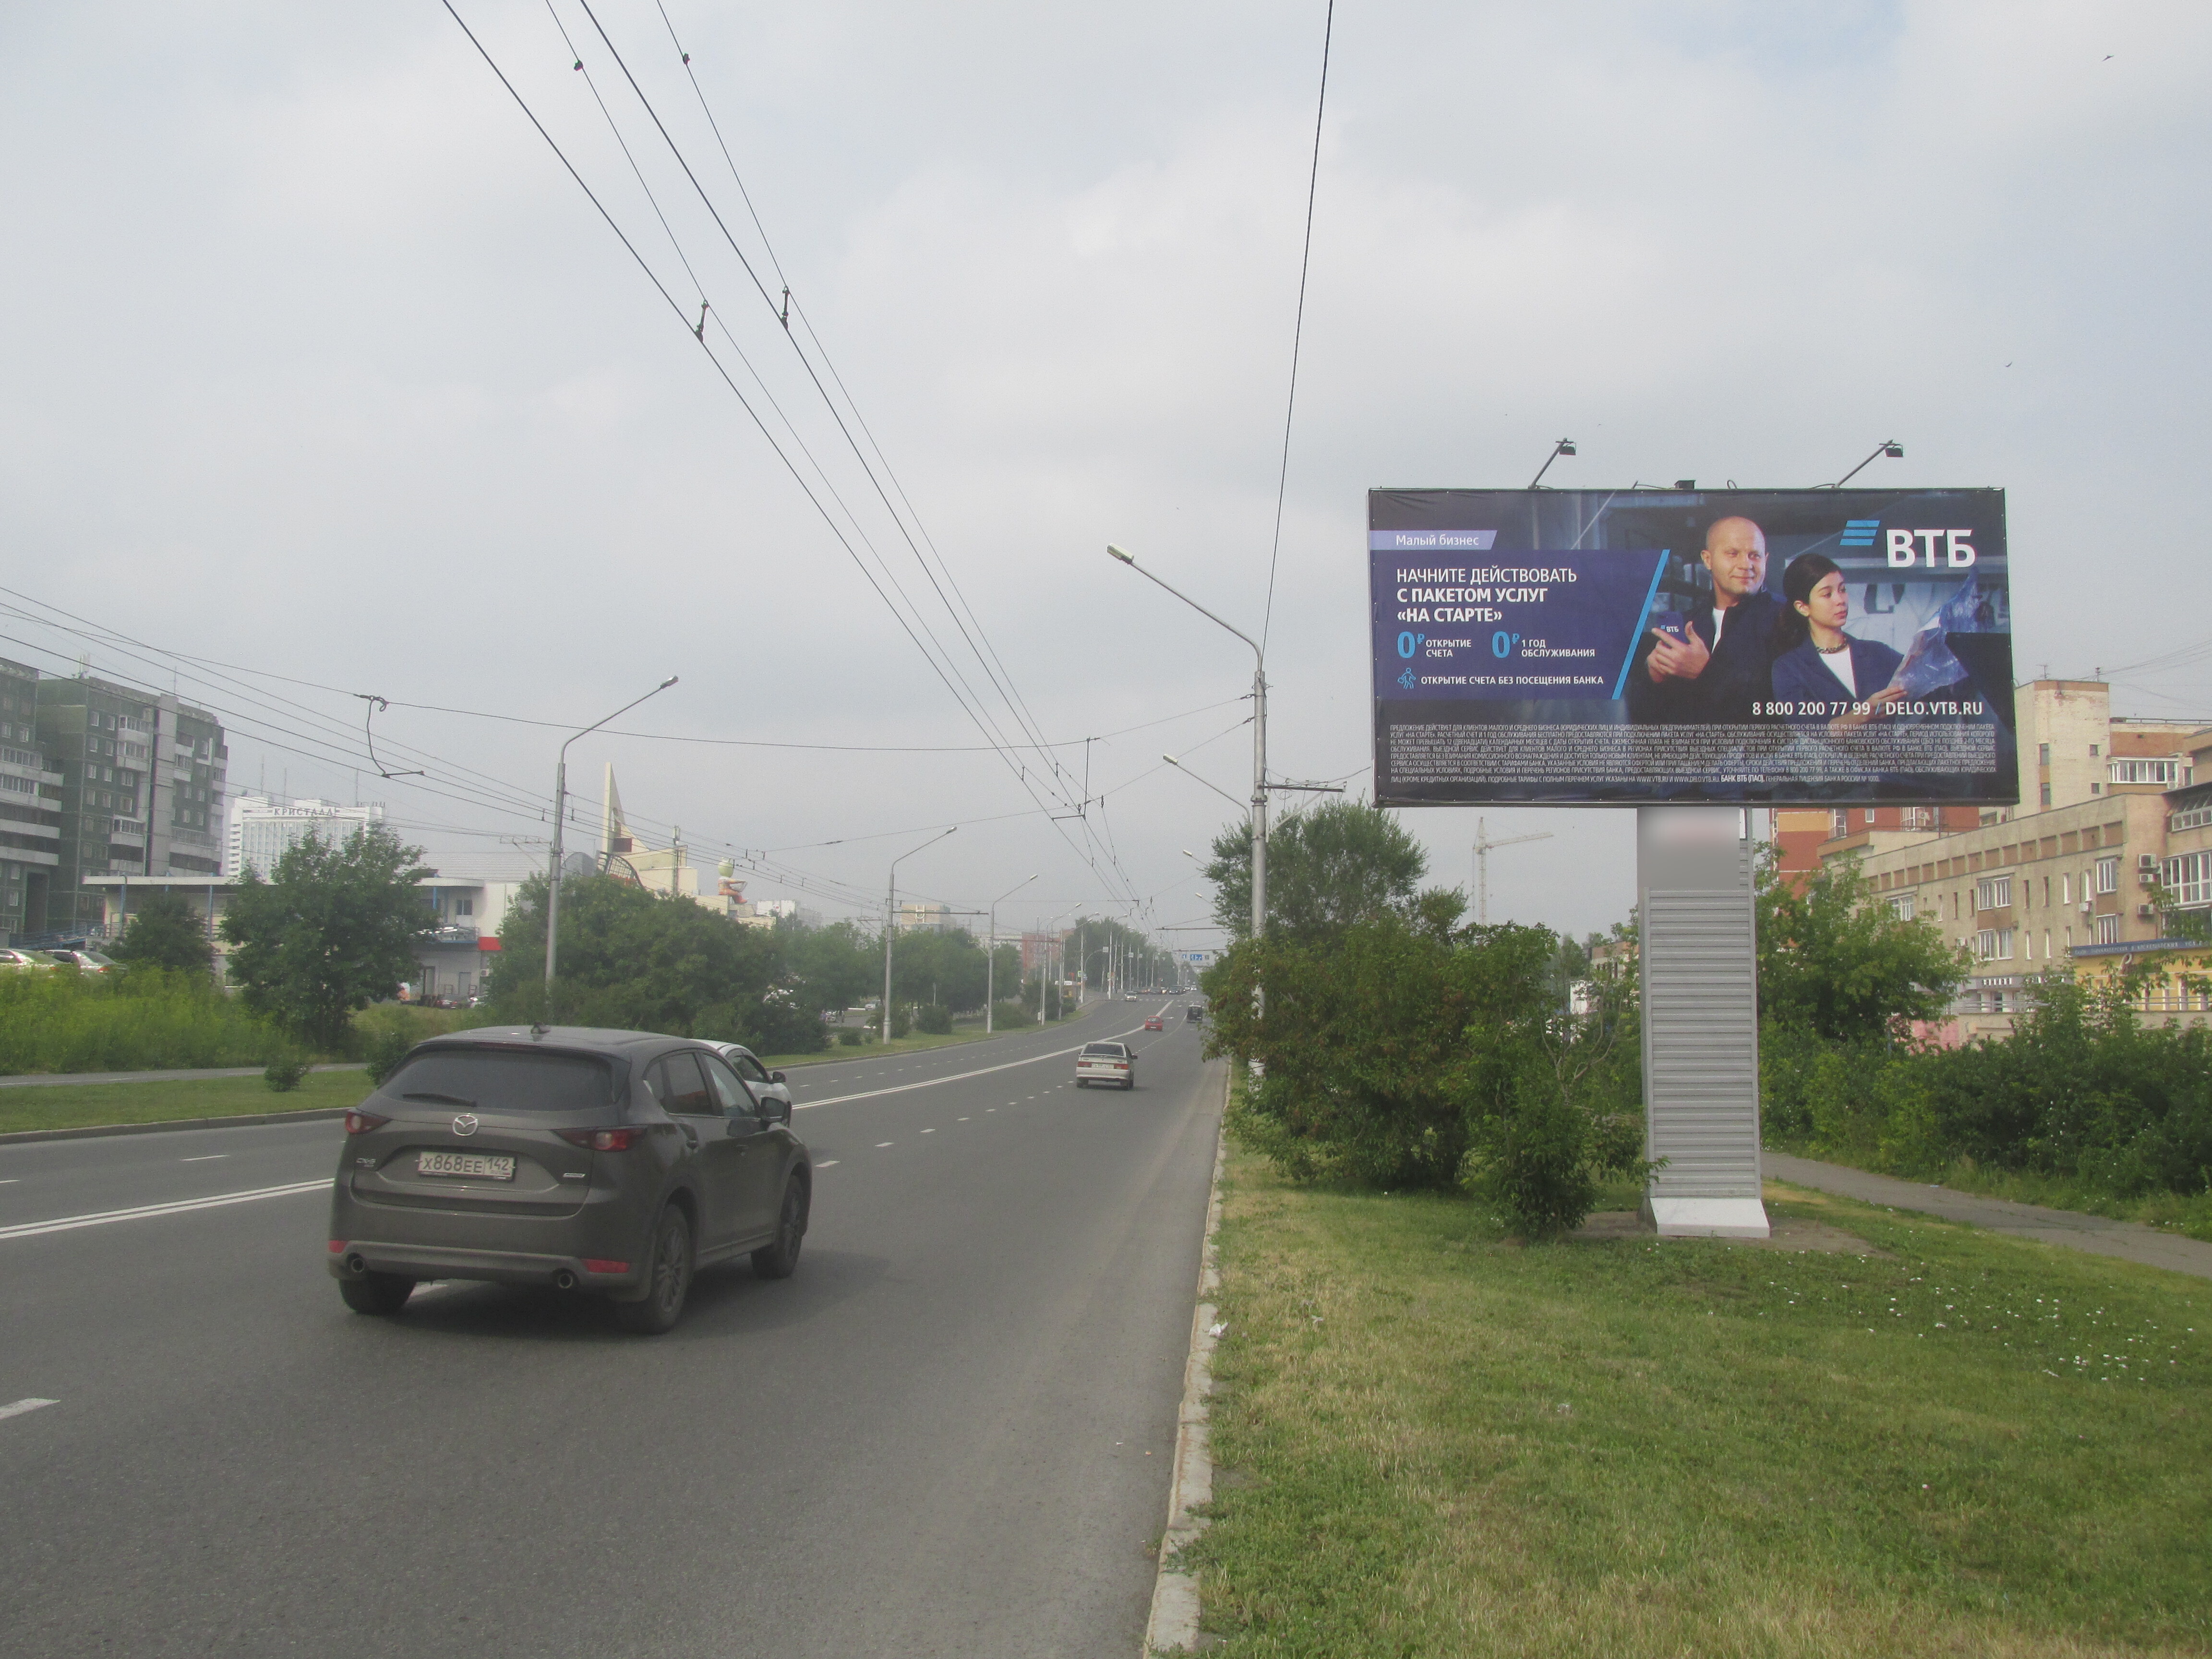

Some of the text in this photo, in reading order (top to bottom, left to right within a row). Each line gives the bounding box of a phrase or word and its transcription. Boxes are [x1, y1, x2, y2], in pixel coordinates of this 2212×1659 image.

[1396, 534, 1479, 545] Малый бизнес
[1887, 529, 1975, 568] ВТБ
[1397, 565, 1577, 585] НАЧНИТЕ ДЕЙСТВОВАТЬ
[1397, 588, 1548, 602] С ПАКЕТОМ УСЛУГ
[1397, 608, 1502, 622] «НА СТАРТЕ»
[1426, 639, 1471, 648] ОТКРЫТИЕ
[1529, 639, 1546, 649] ГОД
[1426, 649, 1453, 657] СЧЕТА
[1521, 649, 1595, 657] ОБСЛУЖИВАНИЯ
[1421, 676, 1467, 685] ОТКРЫТИЕ
[1469, 676, 1496, 685] СЧЕТА
[1516, 676, 1571, 685] ПОСЕЩЕНИЯ
[1574, 676, 1604, 684] БАНКА
[1752, 702, 1761, 715] 8
[1766, 702, 1793, 715] 800
[1798, 702, 1825, 715] 200
[1830, 702, 1847, 715] 77
[1852, 702, 1870, 715] 99
[1886, 701, 1982, 715] DELO.VTB.RU
[274, 808, 333, 816] КРИСТАЛЛ
[487, 1157, 509, 1170] 142
